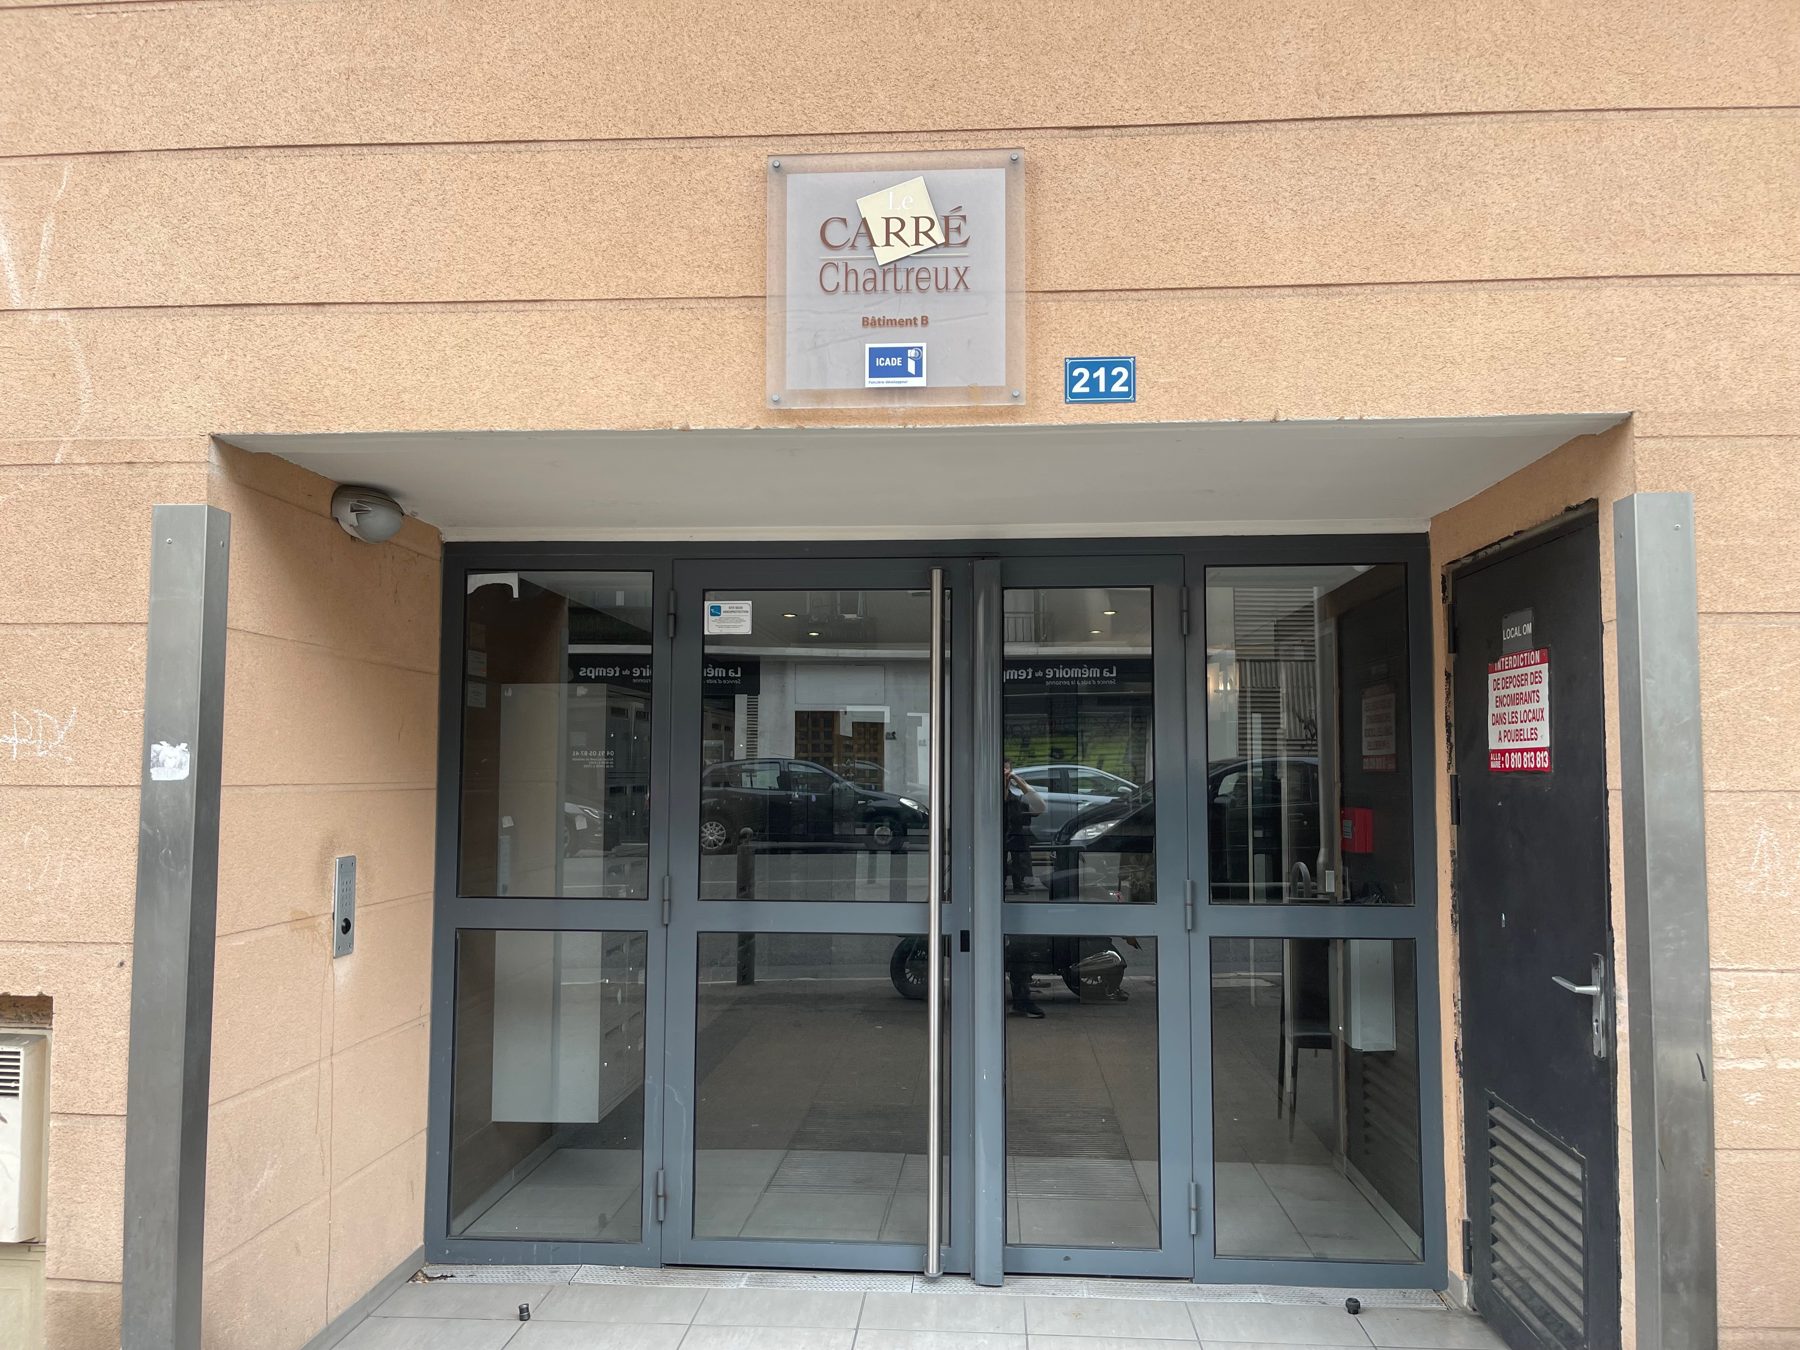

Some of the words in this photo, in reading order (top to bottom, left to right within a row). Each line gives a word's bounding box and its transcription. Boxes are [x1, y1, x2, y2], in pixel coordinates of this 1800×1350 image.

[888, 191, 913, 210] Le
[819, 205, 971, 251] CARRÉ
[819, 262, 971, 296] Chartreux
[862, 315, 918, 327] Bâtiment
[920, 315, 929, 327] B
[875, 357, 903, 367] ICADE
[1072, 367, 1129, 393] 212
[1502, 625, 1522, 640] LOCAL
[1522, 622, 1532, 635] OM
[1494, 649, 1540, 671] INTERDICTION
[1493, 678, 1501, 691] DE
[1502, 672, 1529, 690] DEPOSER
[1530, 670, 1543, 685] DES
[1495, 689, 1540, 708] ENCOMBRANTS
[1492, 711, 1507, 726] DANS
[1508, 710, 1519, 725] LES
[1520, 707, 1545, 724] LOCAUX
[1498, 730, 1502, 743] A
[1503, 727, 1539, 743] POUBELLES
[1505, 752, 1510, 768] 0
[1510, 752, 1522, 768] 810
[1523, 751, 1535, 768] 813
[1536, 750, 1549, 768] 813
